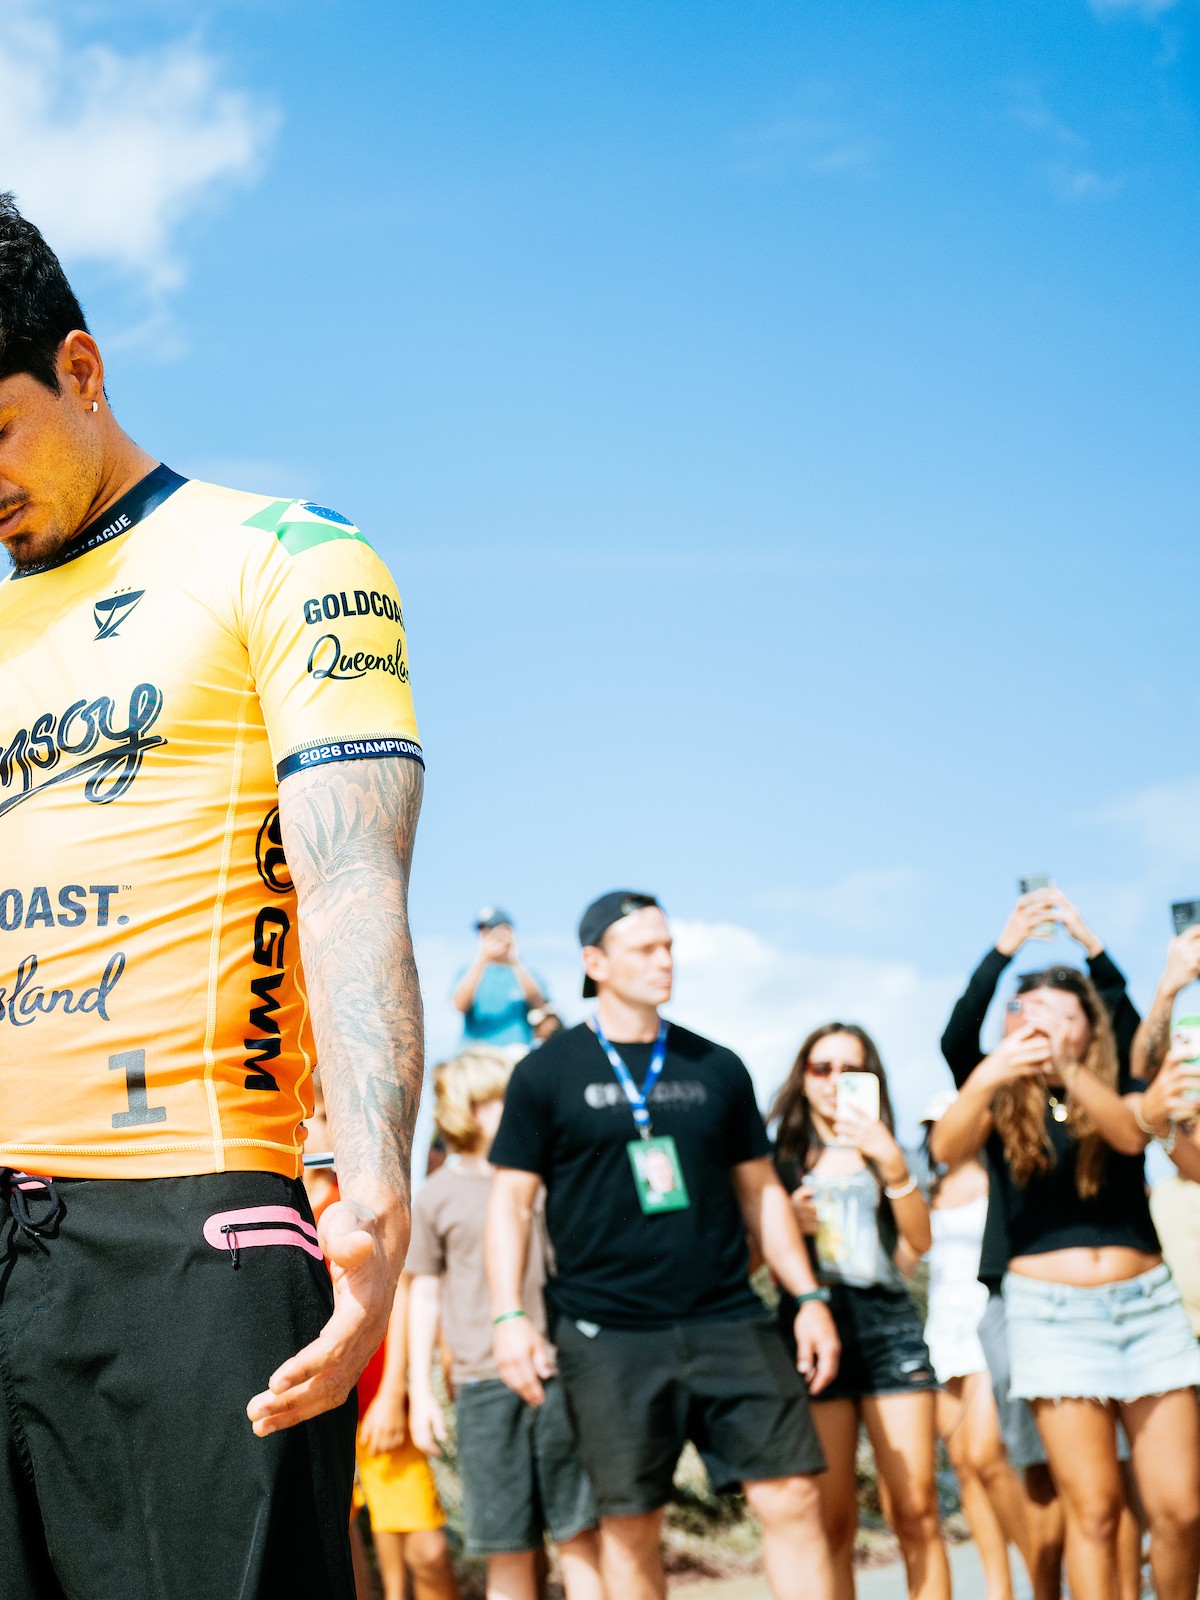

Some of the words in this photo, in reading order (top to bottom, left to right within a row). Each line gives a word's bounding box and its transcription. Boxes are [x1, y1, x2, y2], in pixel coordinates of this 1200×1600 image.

[303, 590, 406, 632] GOLDCOA
[299, 746, 342, 765] 2026
[344, 740, 423, 757] CHAMPIONS
[244, 906, 292, 1092] GWM
[107, 1048, 168, 1129] 1
